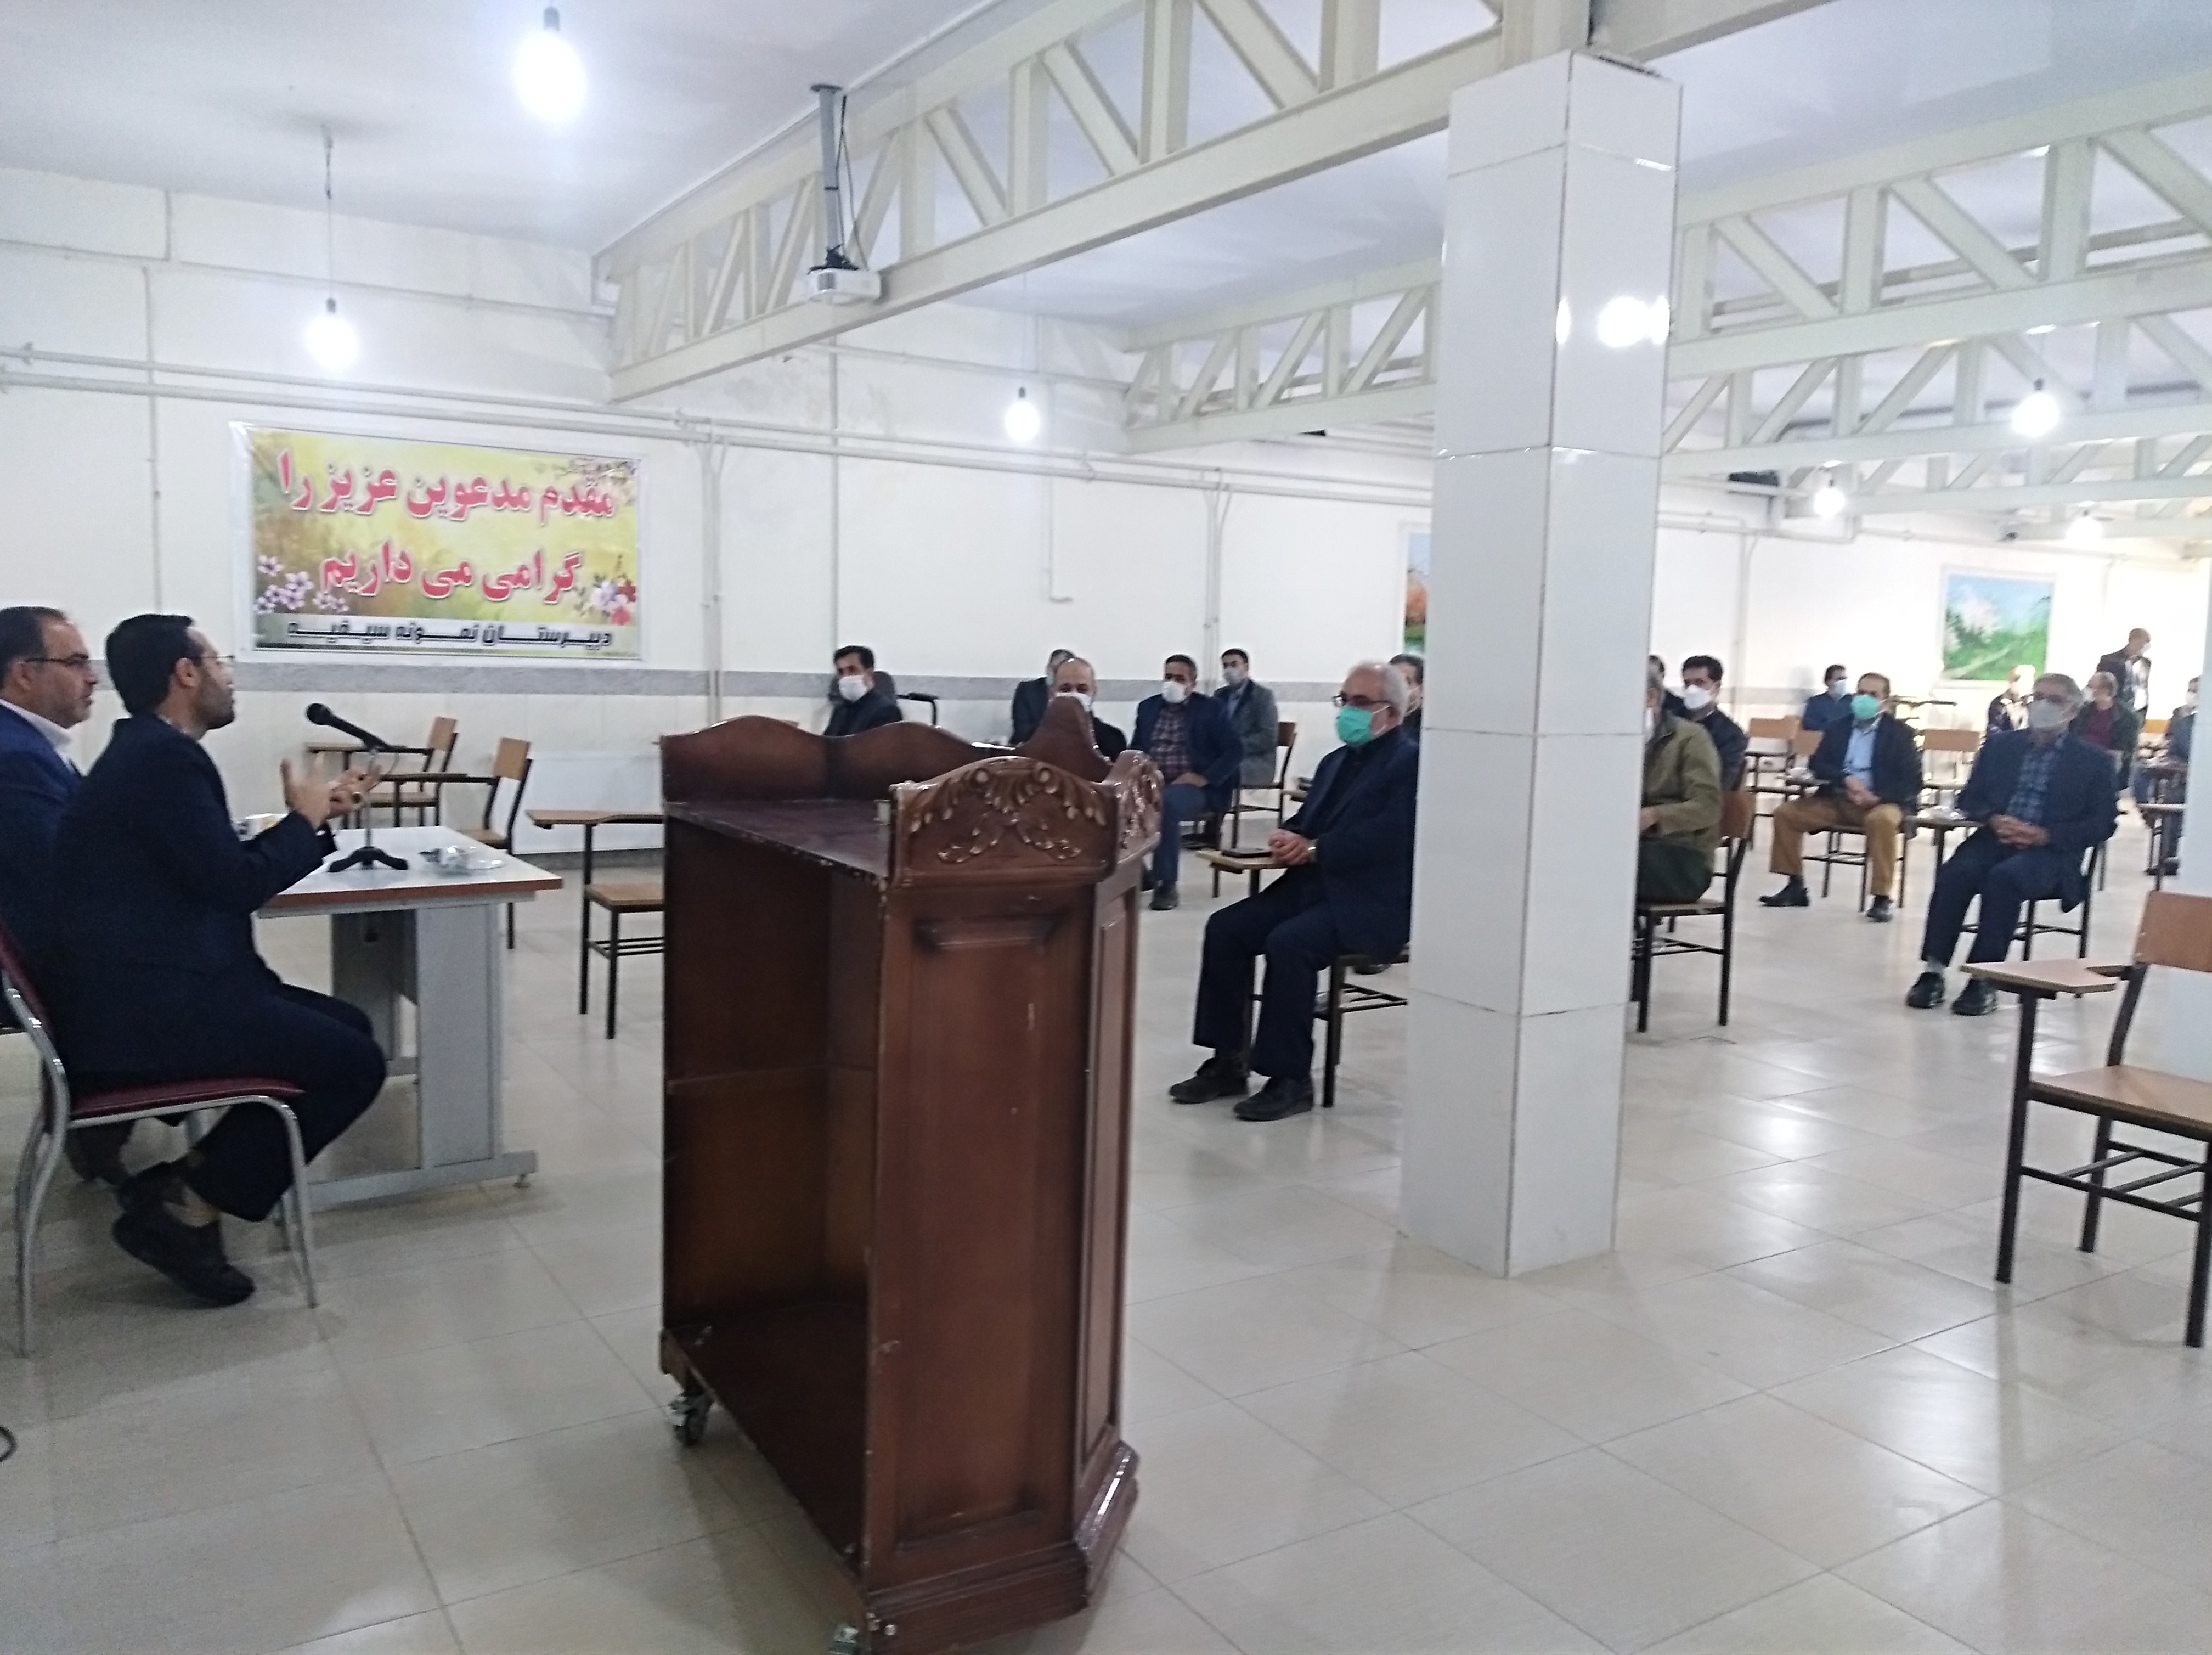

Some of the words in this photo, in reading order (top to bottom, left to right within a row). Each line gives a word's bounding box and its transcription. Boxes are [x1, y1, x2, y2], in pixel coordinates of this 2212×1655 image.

[278, 448, 311, 511] را
[318, 463, 397, 515] عزیز
[407, 475, 530, 521] مدعوین
[540, 473, 613, 526] مقدم
[320, 540, 411, 596] داریم
[422, 560, 472, 599] می
[481, 549, 581, 604] گرامی
[396, 622, 479, 644] نمونه
[483, 624, 612, 650] دبیرستان
